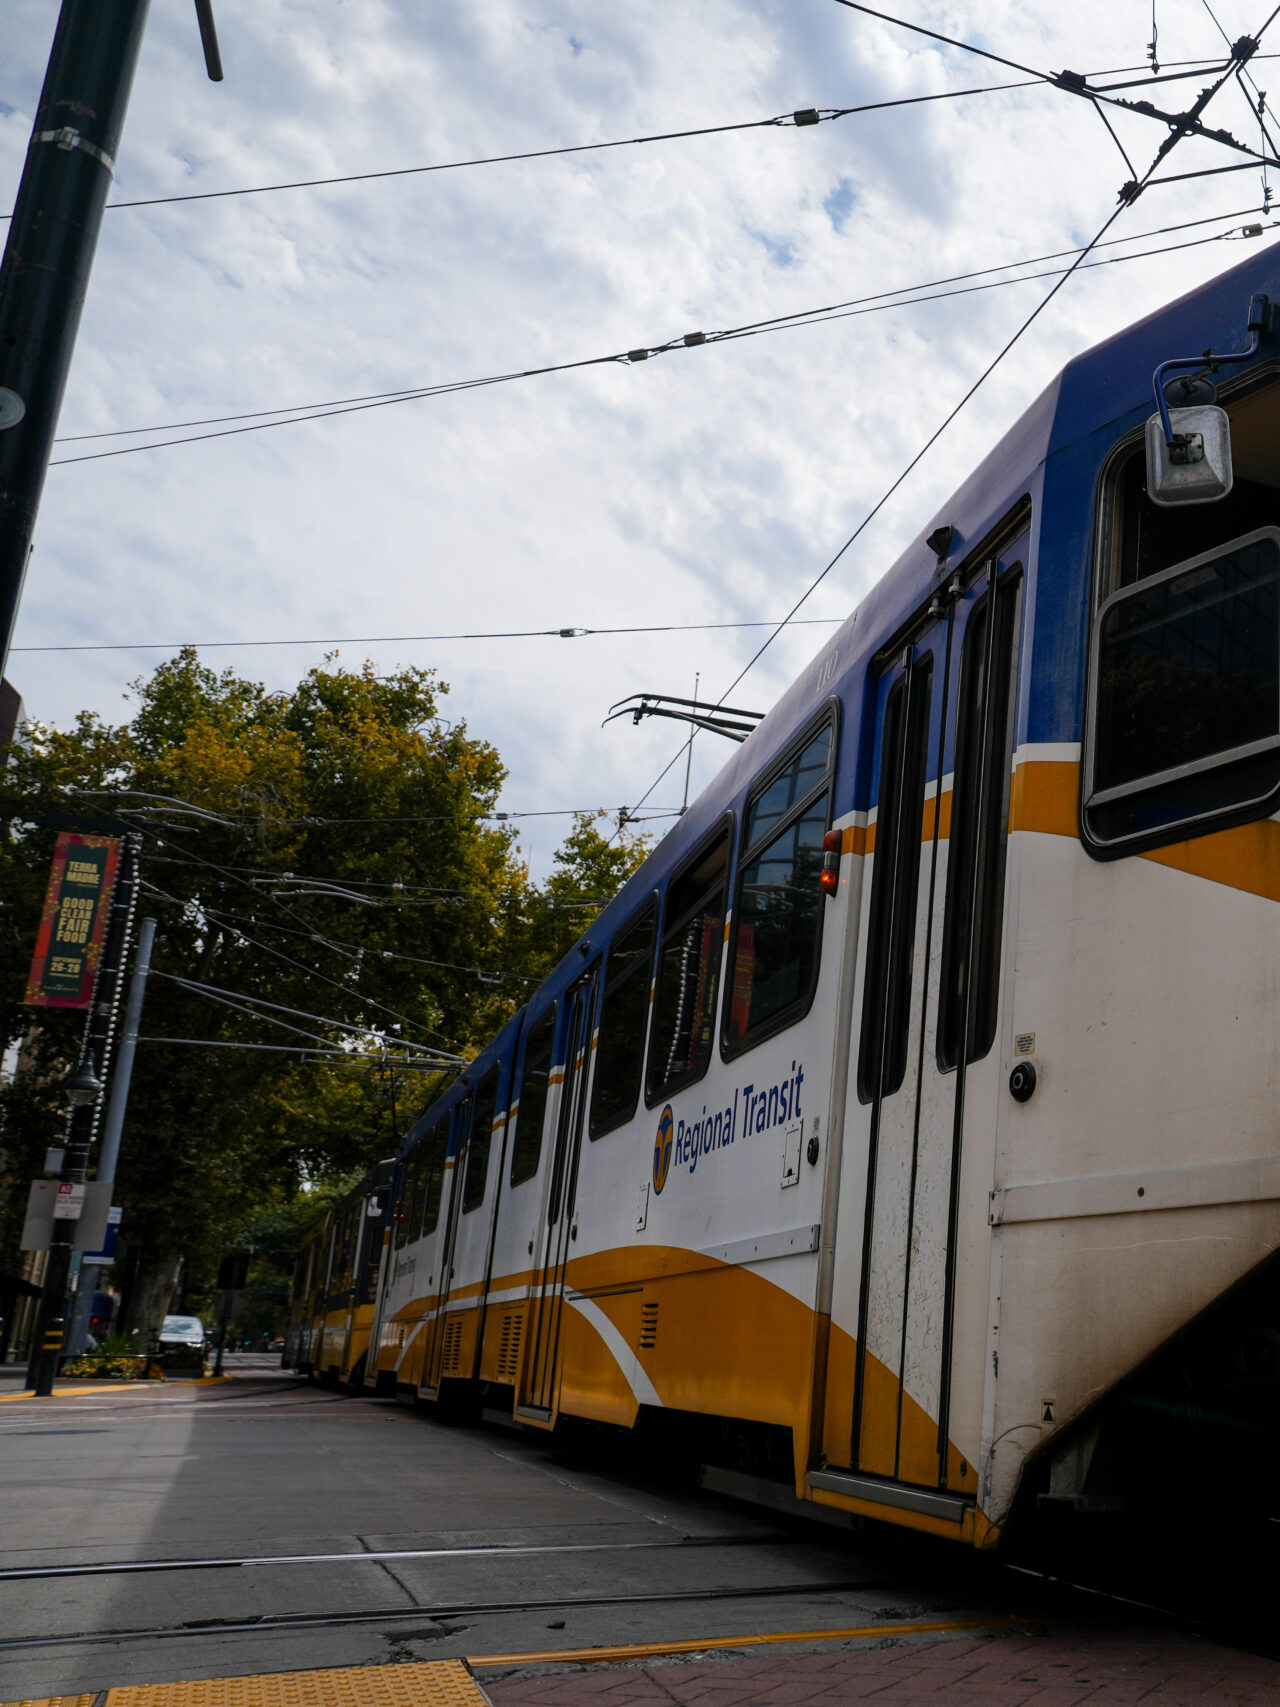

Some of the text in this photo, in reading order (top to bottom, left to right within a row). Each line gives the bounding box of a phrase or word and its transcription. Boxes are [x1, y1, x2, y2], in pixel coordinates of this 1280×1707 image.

[69, 861, 98, 873] TERRA
[66, 871, 100, 884] MADRE
[62, 896, 94, 910] GOOD
[60, 908, 93, 920] CLEAN
[58, 918, 90, 933] FAIR
[56, 930, 87, 943] FOOD
[50, 962, 81, 973] 26-28
[674, 1060, 804, 1174] Regional Transit
